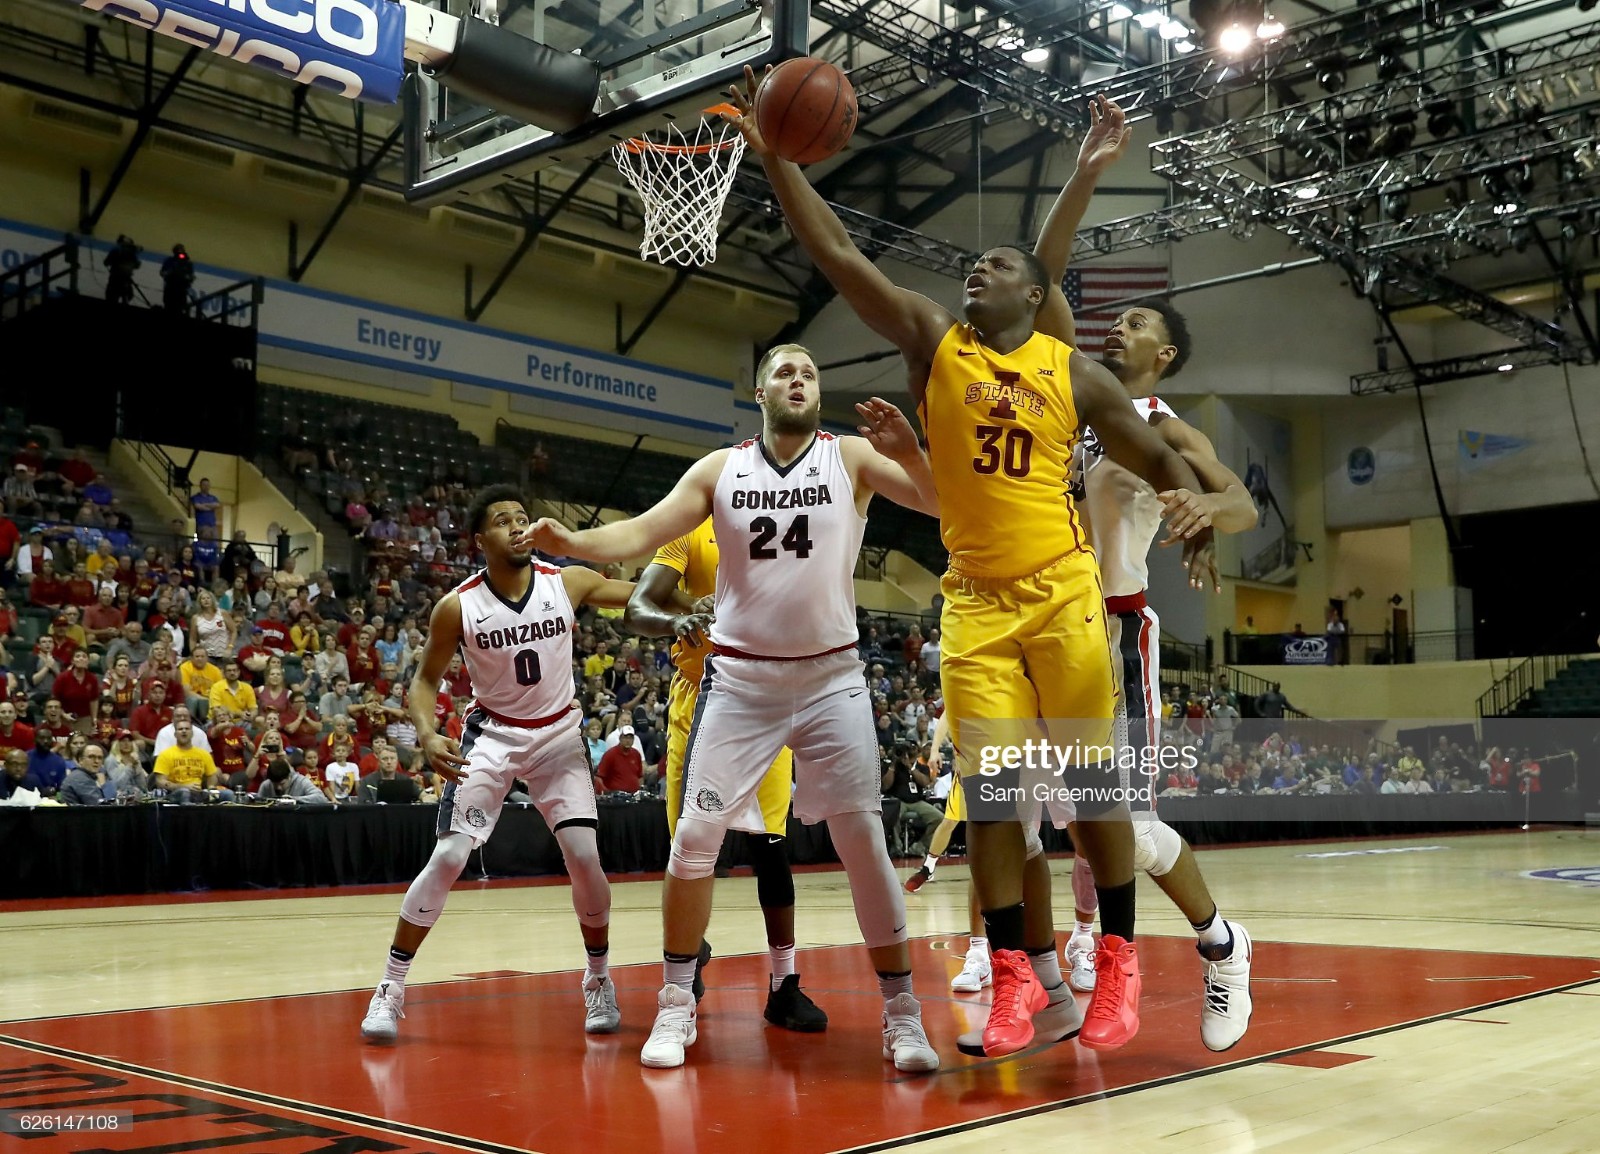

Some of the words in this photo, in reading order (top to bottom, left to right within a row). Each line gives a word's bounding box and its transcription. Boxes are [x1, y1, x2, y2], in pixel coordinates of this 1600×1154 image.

[357, 318, 442, 362] Energy
[526, 354, 657, 402] Performance
[965, 381, 1047, 418] STATE
[973, 425, 1034, 478] 30
[731, 484, 833, 510] GONZAGA
[749, 514, 813, 560] 24
[475, 616, 567, 650] GONZAGA
[513, 648, 542, 687] 0
